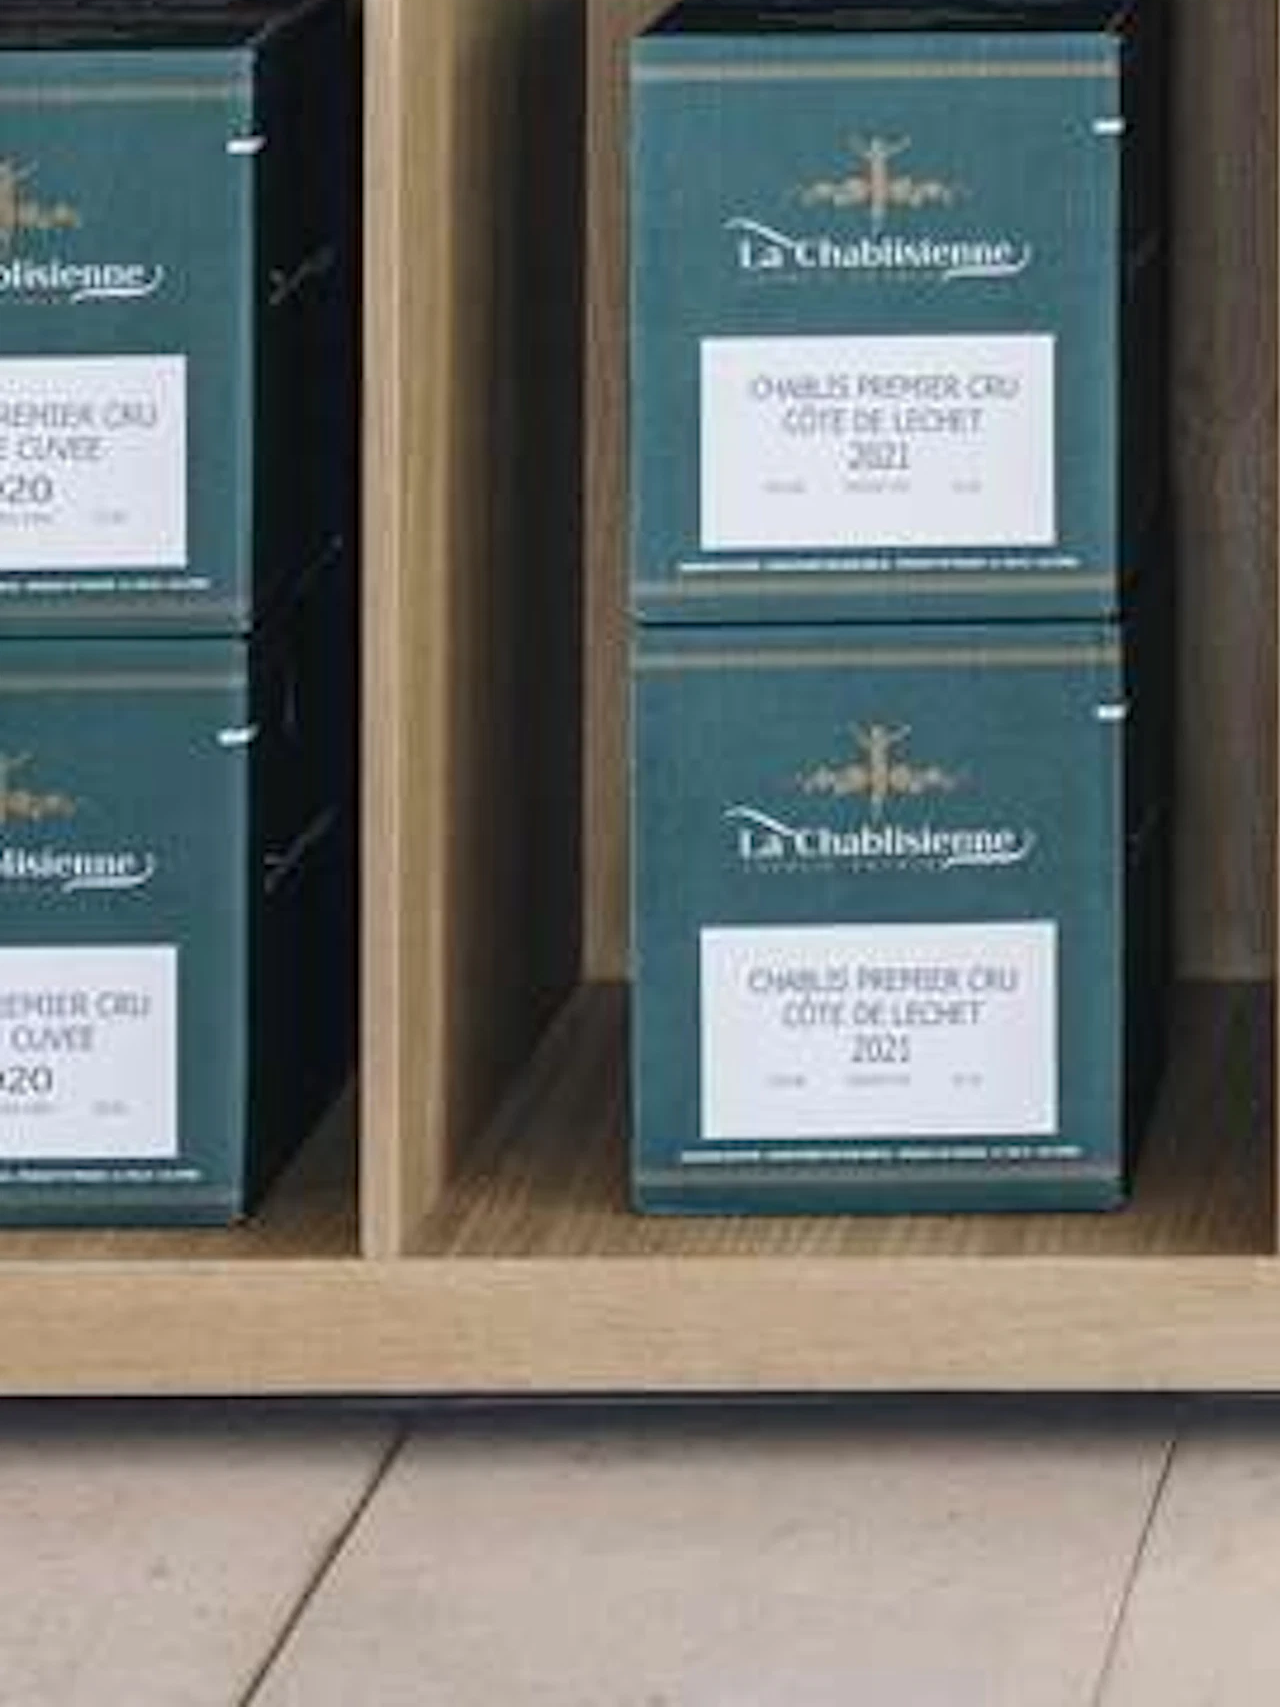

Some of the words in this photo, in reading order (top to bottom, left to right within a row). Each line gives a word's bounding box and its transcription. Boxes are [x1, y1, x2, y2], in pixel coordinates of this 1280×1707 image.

[795, 237, 1027, 277] Chablisienne
[966, 373, 1020, 400] CRU
[102, 401, 157, 430] CRU
[853, 407, 881, 435] DE
[795, 824, 1029, 865] Chablisienne
[967, 966, 1019, 992] CRU
[852, 999, 881, 1026] DE
[850, 1035, 910, 1064] 2021
